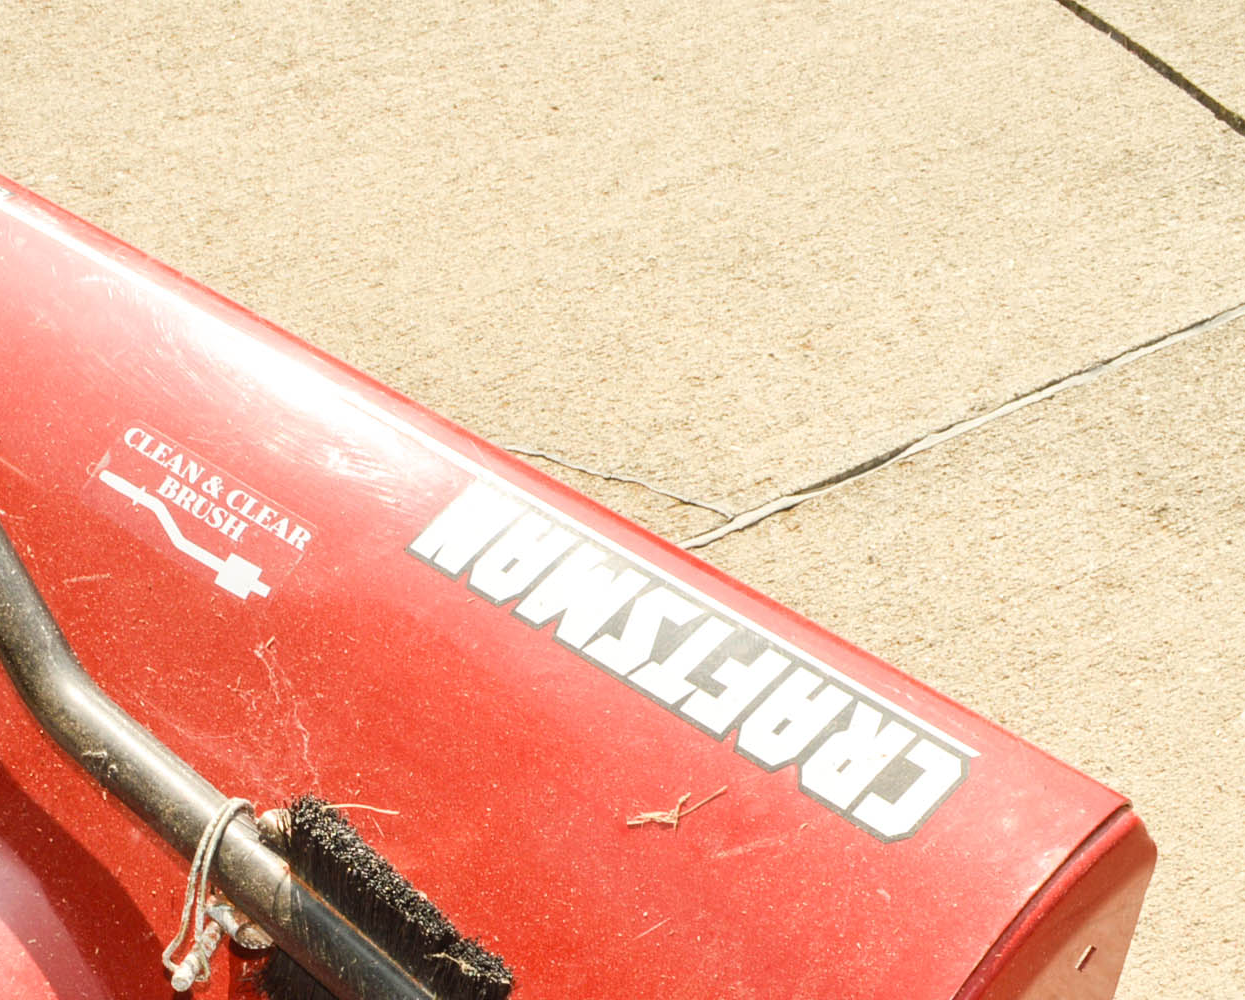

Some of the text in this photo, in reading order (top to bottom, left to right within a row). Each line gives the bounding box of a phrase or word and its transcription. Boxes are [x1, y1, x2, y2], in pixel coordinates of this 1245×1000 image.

[124, 428, 312, 551] CLEAN & CLEAR
[156, 475, 250, 542] BRUSH
[406, 481, 967, 841] CRAFTSMAN
